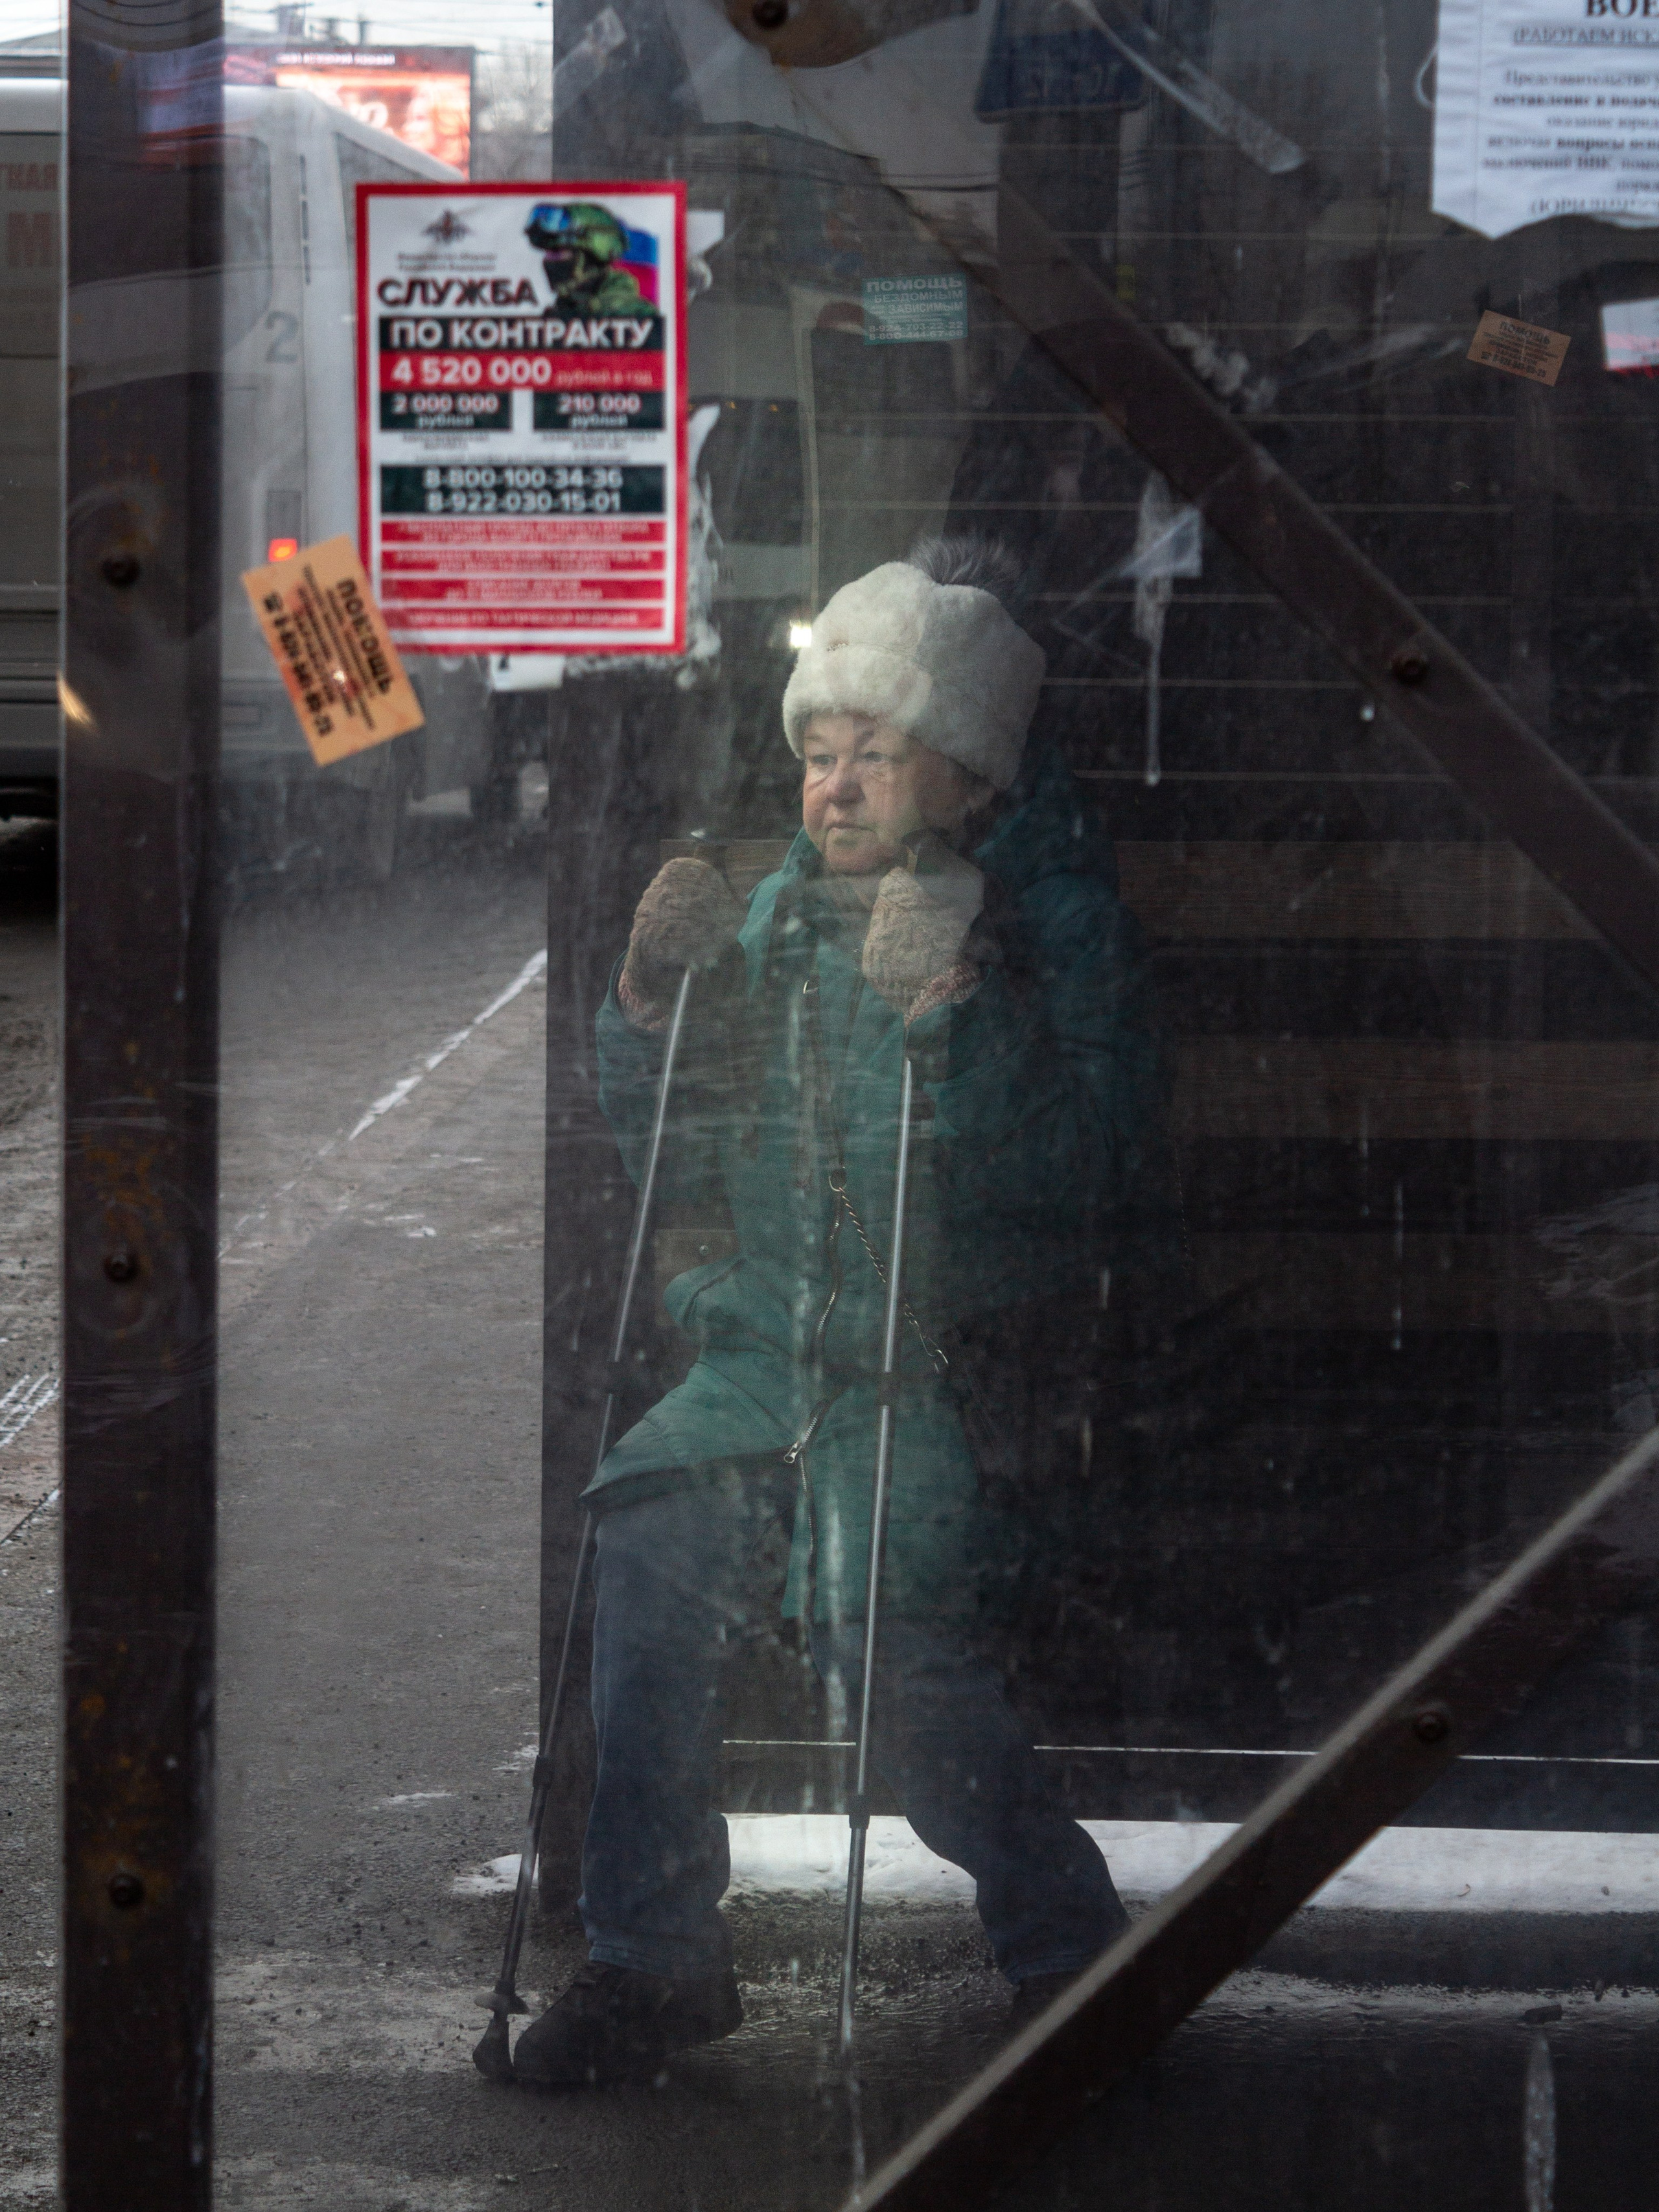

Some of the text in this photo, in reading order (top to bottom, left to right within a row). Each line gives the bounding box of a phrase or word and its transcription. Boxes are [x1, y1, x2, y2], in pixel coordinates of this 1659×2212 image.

[377, 278, 539, 308] СЛУЖБА
[866, 277, 963, 292] ПОМОЩЬ
[875, 290, 963, 303] БЕЗДОМНЫМ
[888, 301, 964, 314] ЗАВИСИМЫМ
[391, 320, 654, 349] ПО КОНТРАКТУ
[393, 357, 413, 384] 4
[421, 356, 482, 385] 520
[491, 356, 552, 386] 000
[393, 393, 501, 414] 2 000 000
[558, 393, 642, 414] 210 000
[424, 467, 623, 489] 8-800-100-34-36
[426, 491, 621, 513] 8-922-030-15-01
